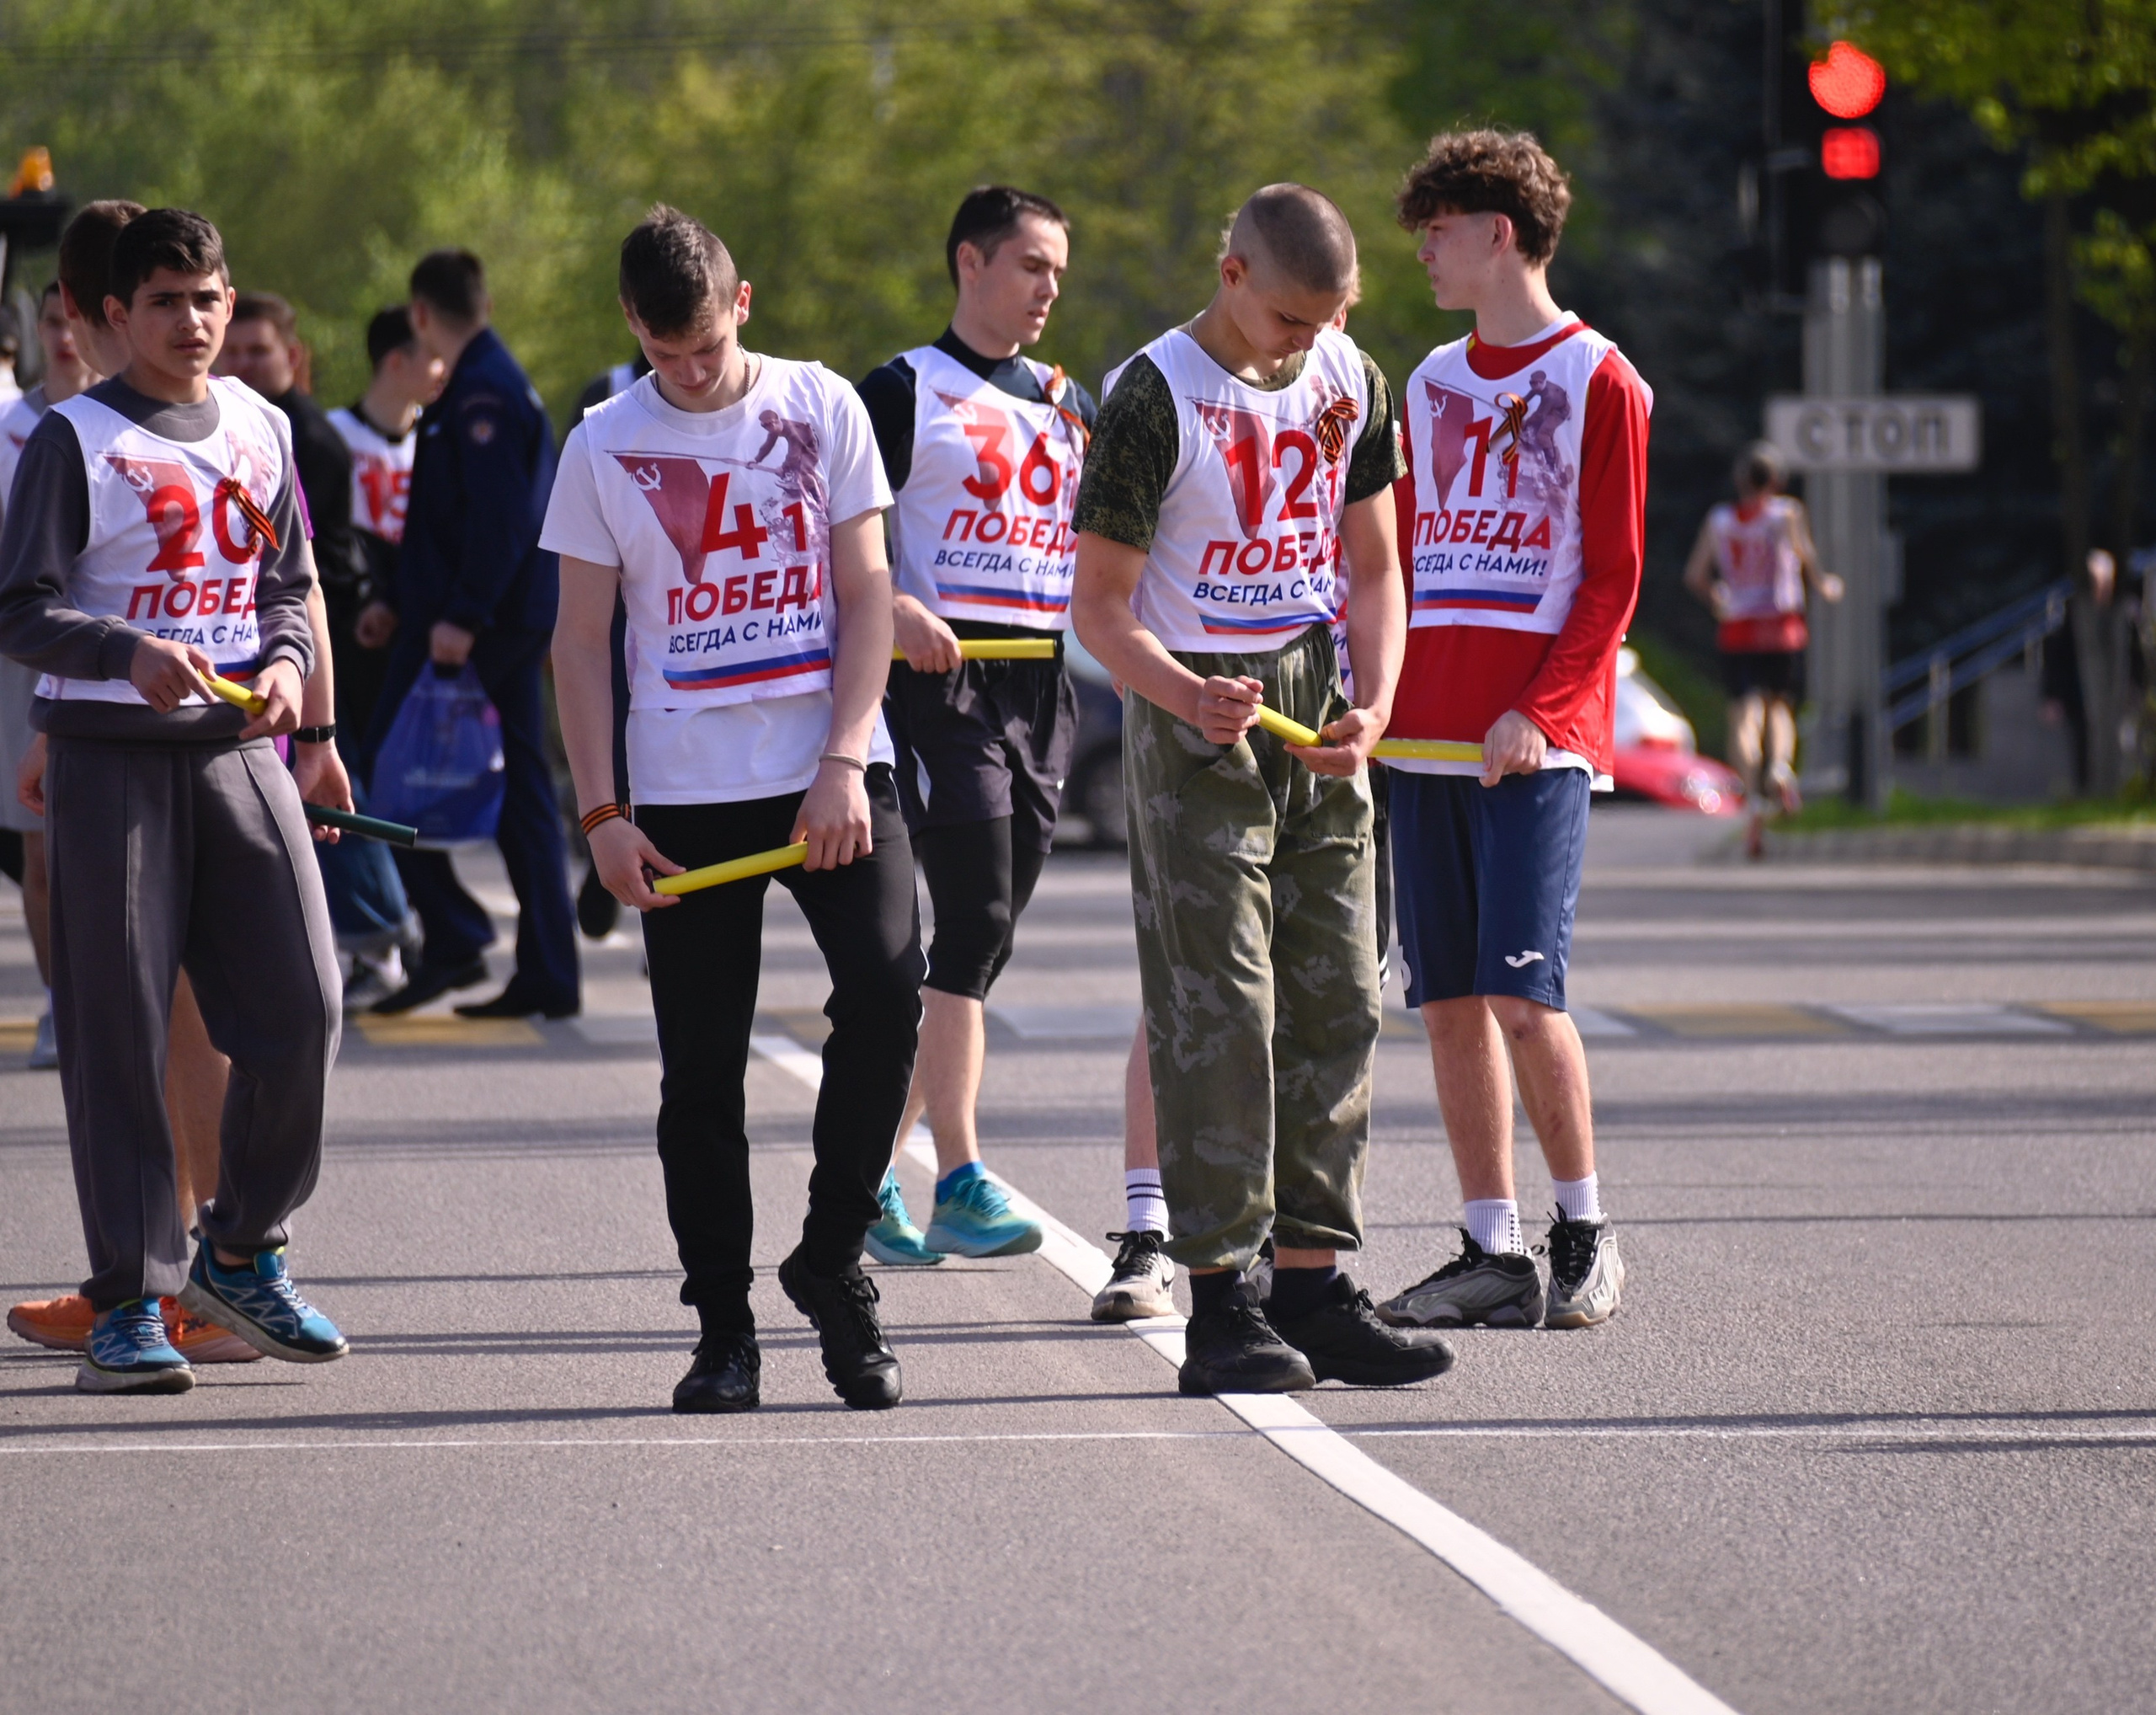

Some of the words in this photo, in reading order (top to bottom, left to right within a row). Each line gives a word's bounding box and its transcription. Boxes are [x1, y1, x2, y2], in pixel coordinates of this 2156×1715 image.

[1796, 403, 1950, 461] СТОП
[962, 424, 1061, 506] 36
[1225, 430, 1318, 526] 12
[147, 478, 253, 572] 20
[1414, 510, 1550, 553] ПОБЕДА
[934, 550, 1011, 573] ВСЕГДА
[1018, 558, 1032, 573] С
[1414, 553, 1453, 574] СЕГДА
[1460, 553, 1473, 570] С
[1476, 556, 1548, 576] НАМИ!
[1193, 582, 1283, 606] ВСЕГДА
[1290, 580, 1305, 599] С
[211, 625, 227, 644] С
[743, 622, 759, 641] С
